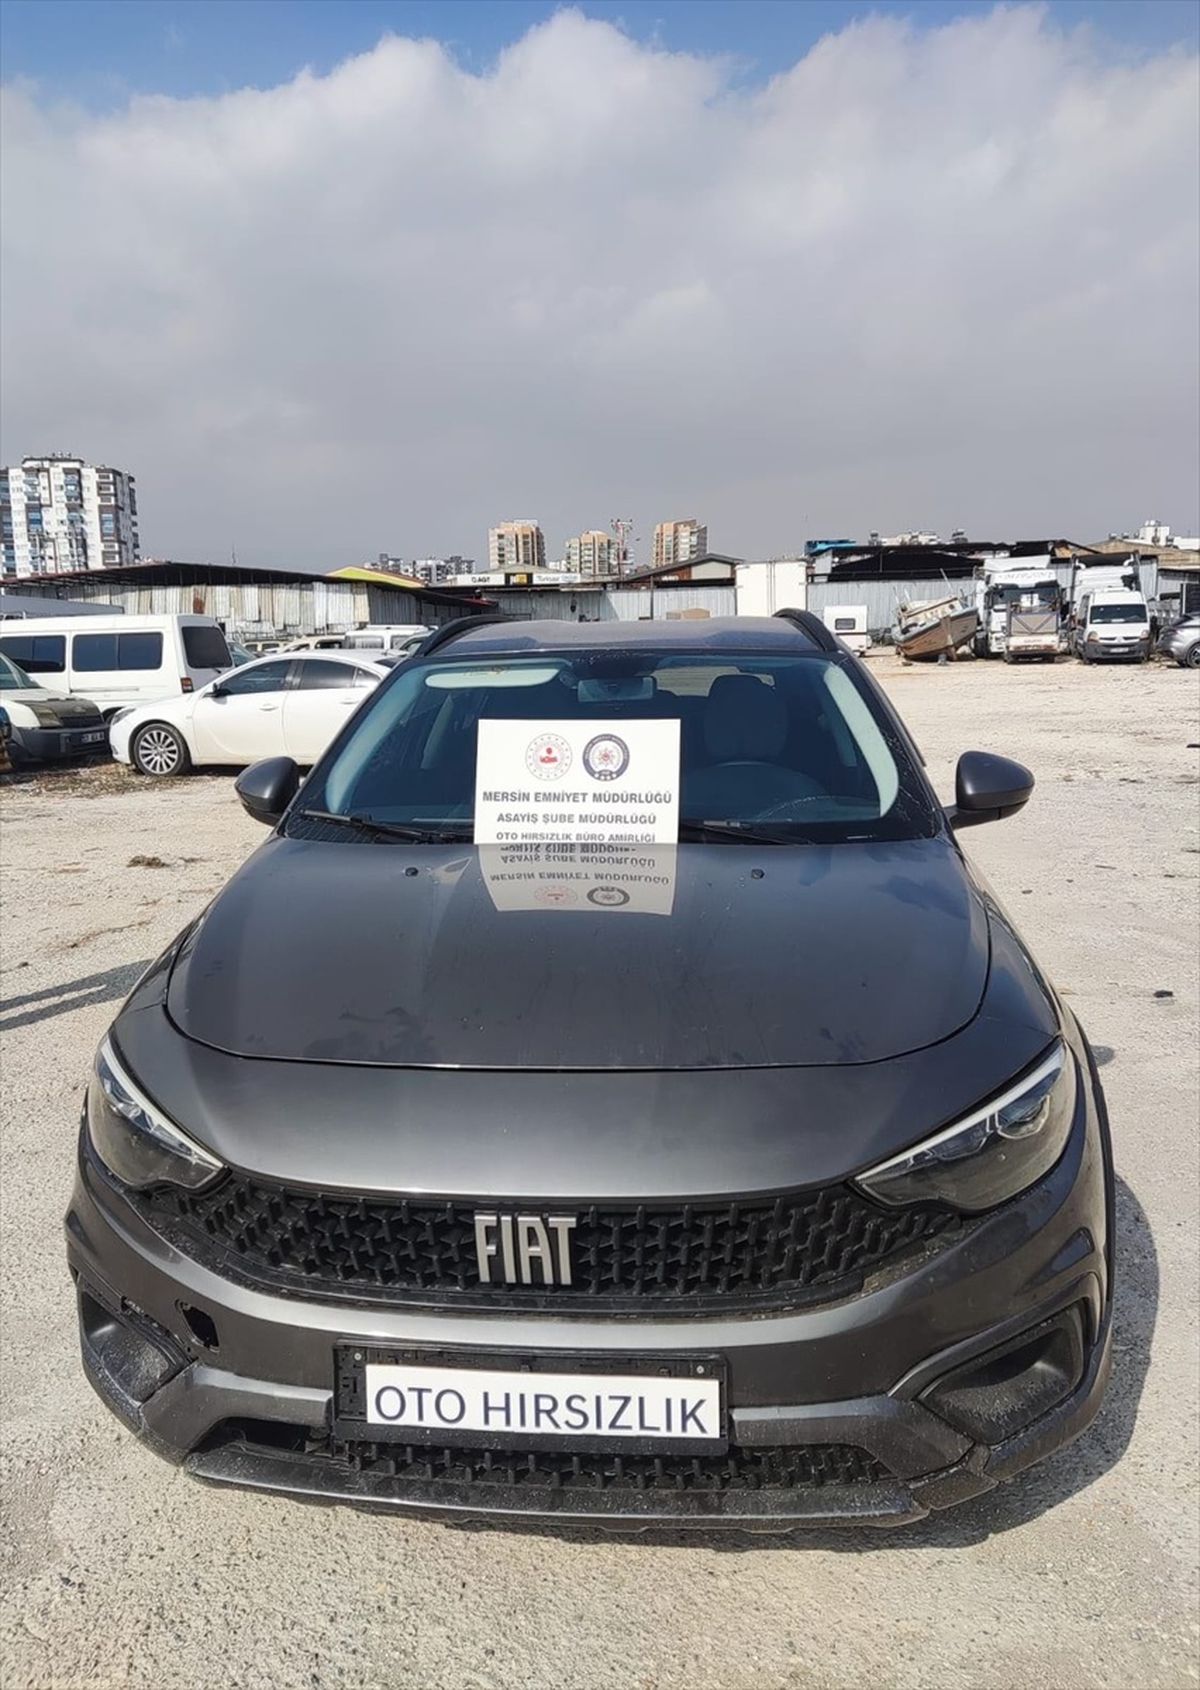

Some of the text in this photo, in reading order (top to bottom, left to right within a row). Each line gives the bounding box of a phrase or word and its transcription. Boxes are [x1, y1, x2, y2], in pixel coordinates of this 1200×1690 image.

[482, 790, 672, 804] MERSİN EMNİYET MÜDÜRLÜĞÜ
[497, 812, 656, 825] ASAYİŞ ŞUBE MÜDÜRLÜĞÜ
[496, 831, 656, 843] OTO HIRSIZLIK BÜRO AMİRLİĞİ
[474, 1213, 577, 1286] FIAT
[374, 1385, 709, 1434] OTO HIRSIZLIK
